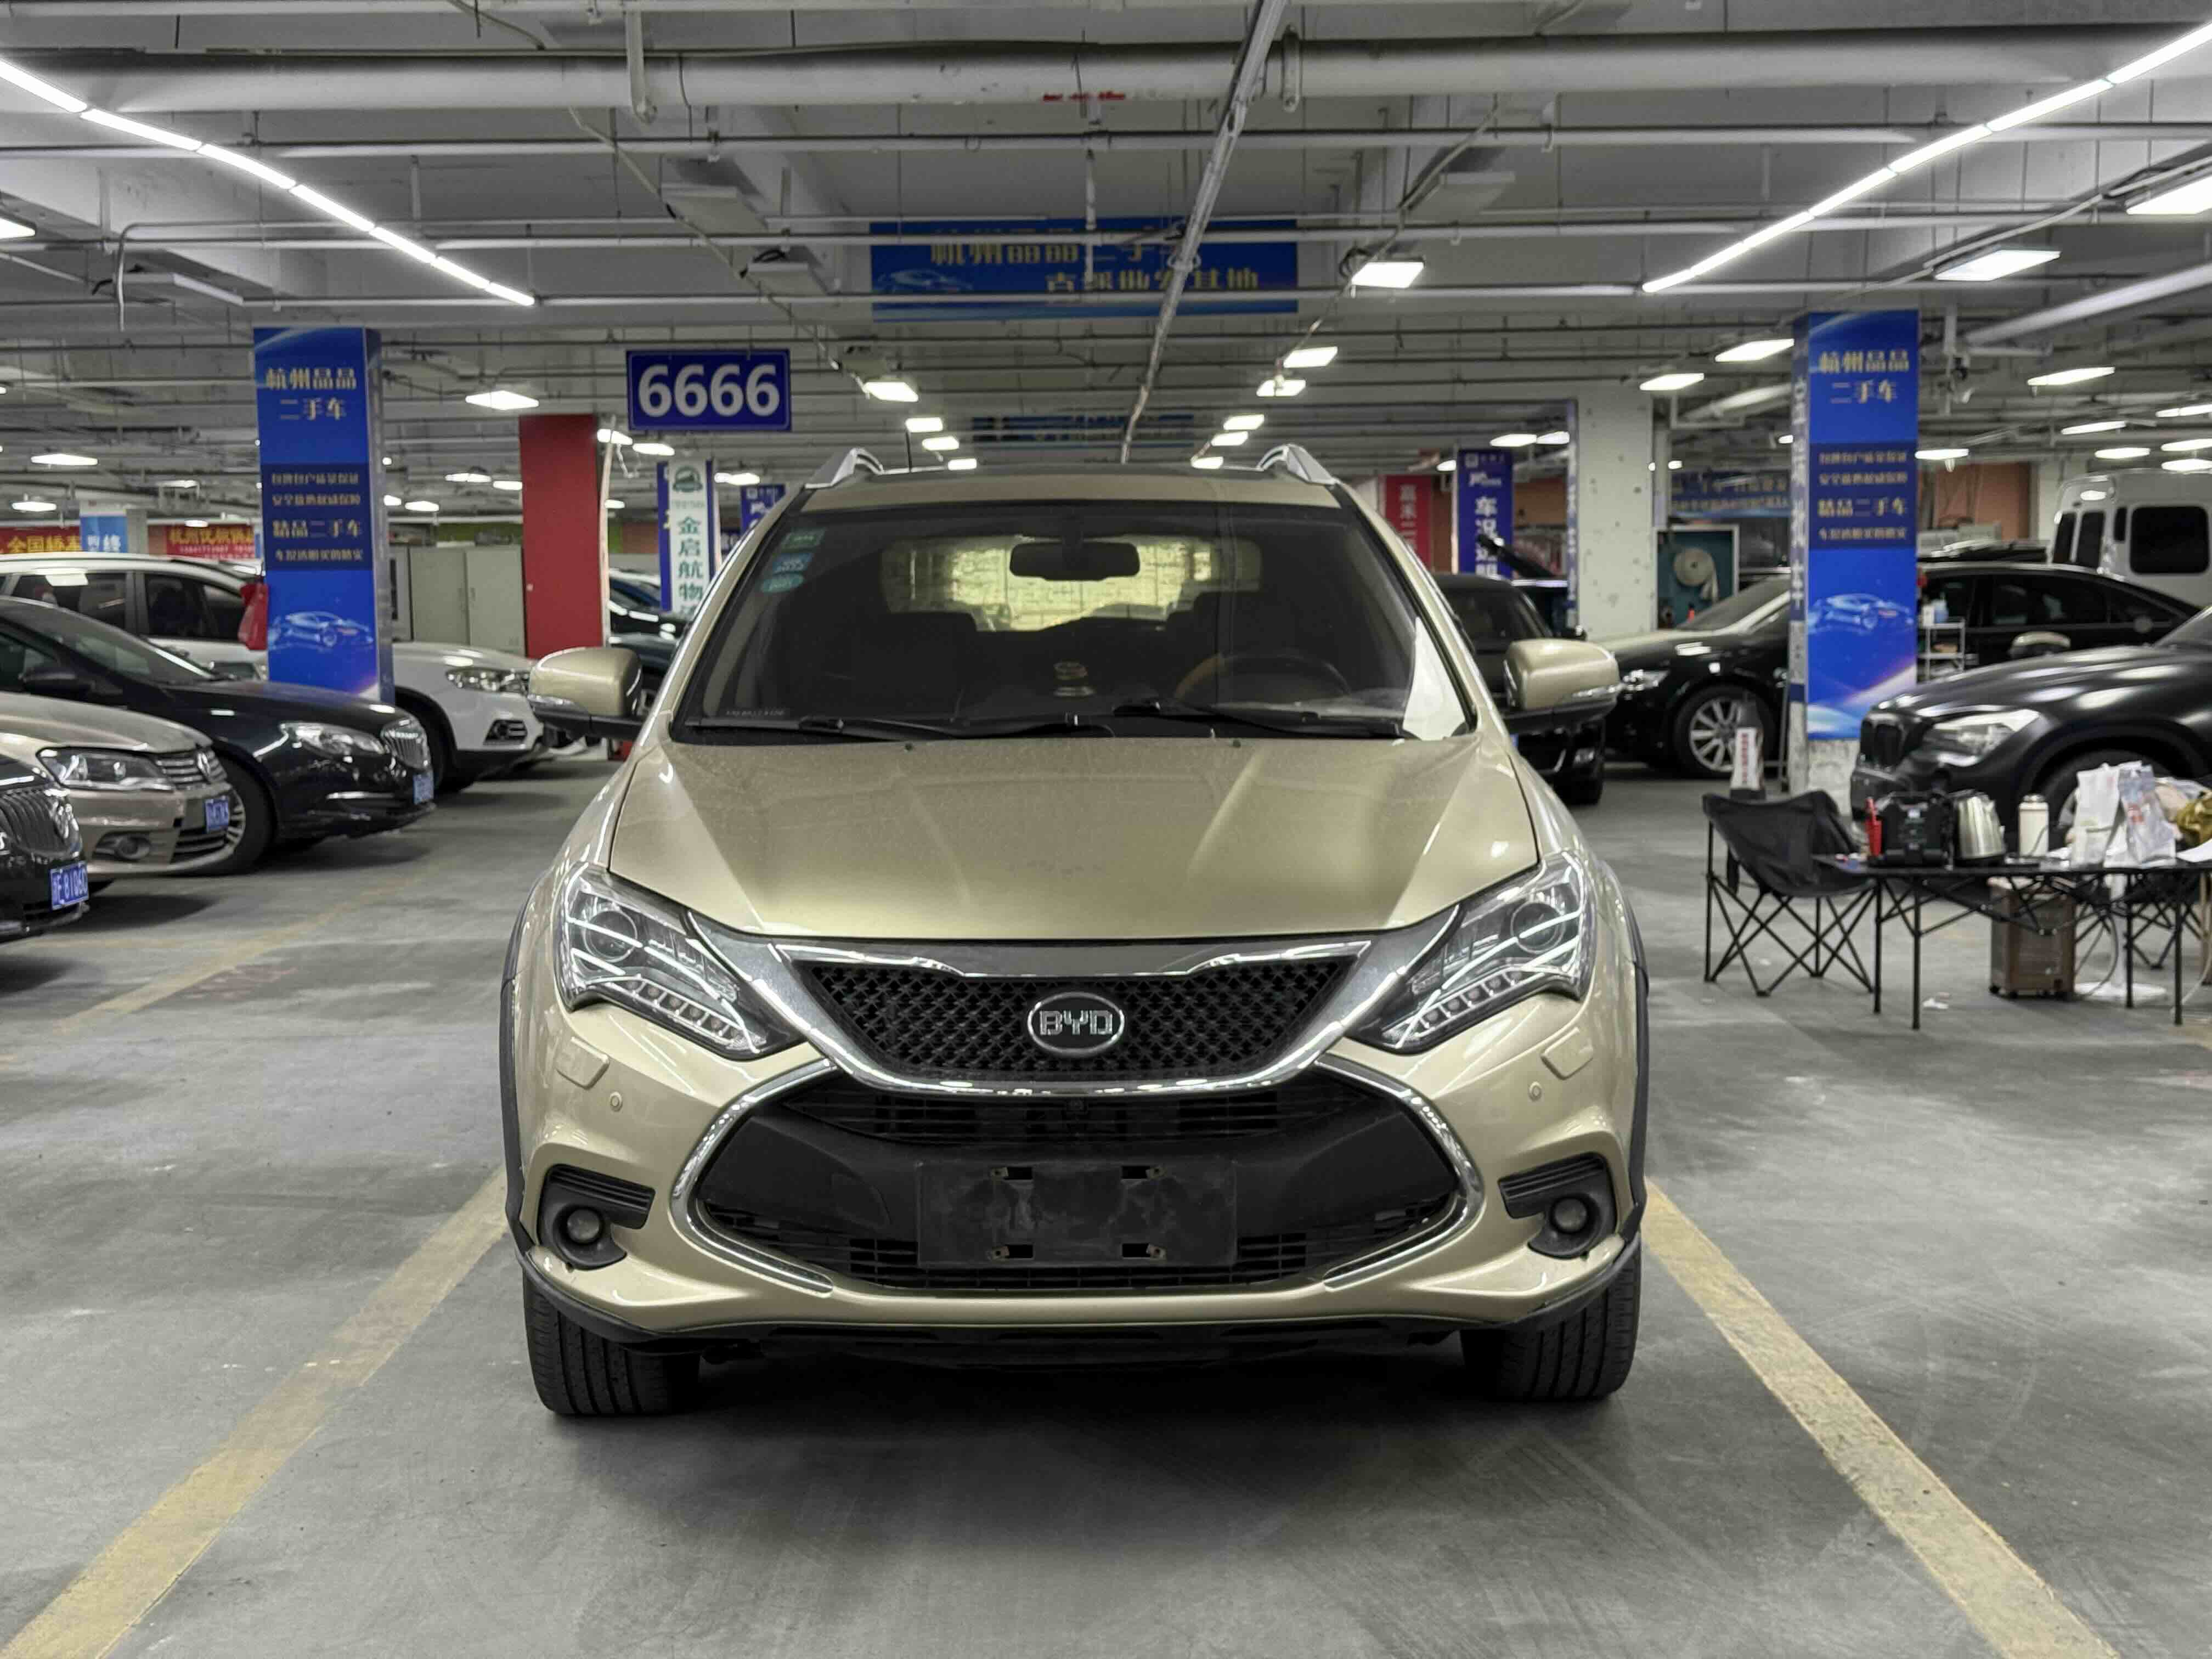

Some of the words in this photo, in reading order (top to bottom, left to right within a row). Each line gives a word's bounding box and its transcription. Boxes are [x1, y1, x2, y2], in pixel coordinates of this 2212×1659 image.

[638, 364, 780, 417] 6666
[1830, 378, 1898, 404] 二手车
[280, 397, 347, 421] 二手车
[1040, 1010, 1113, 1036] BYD
